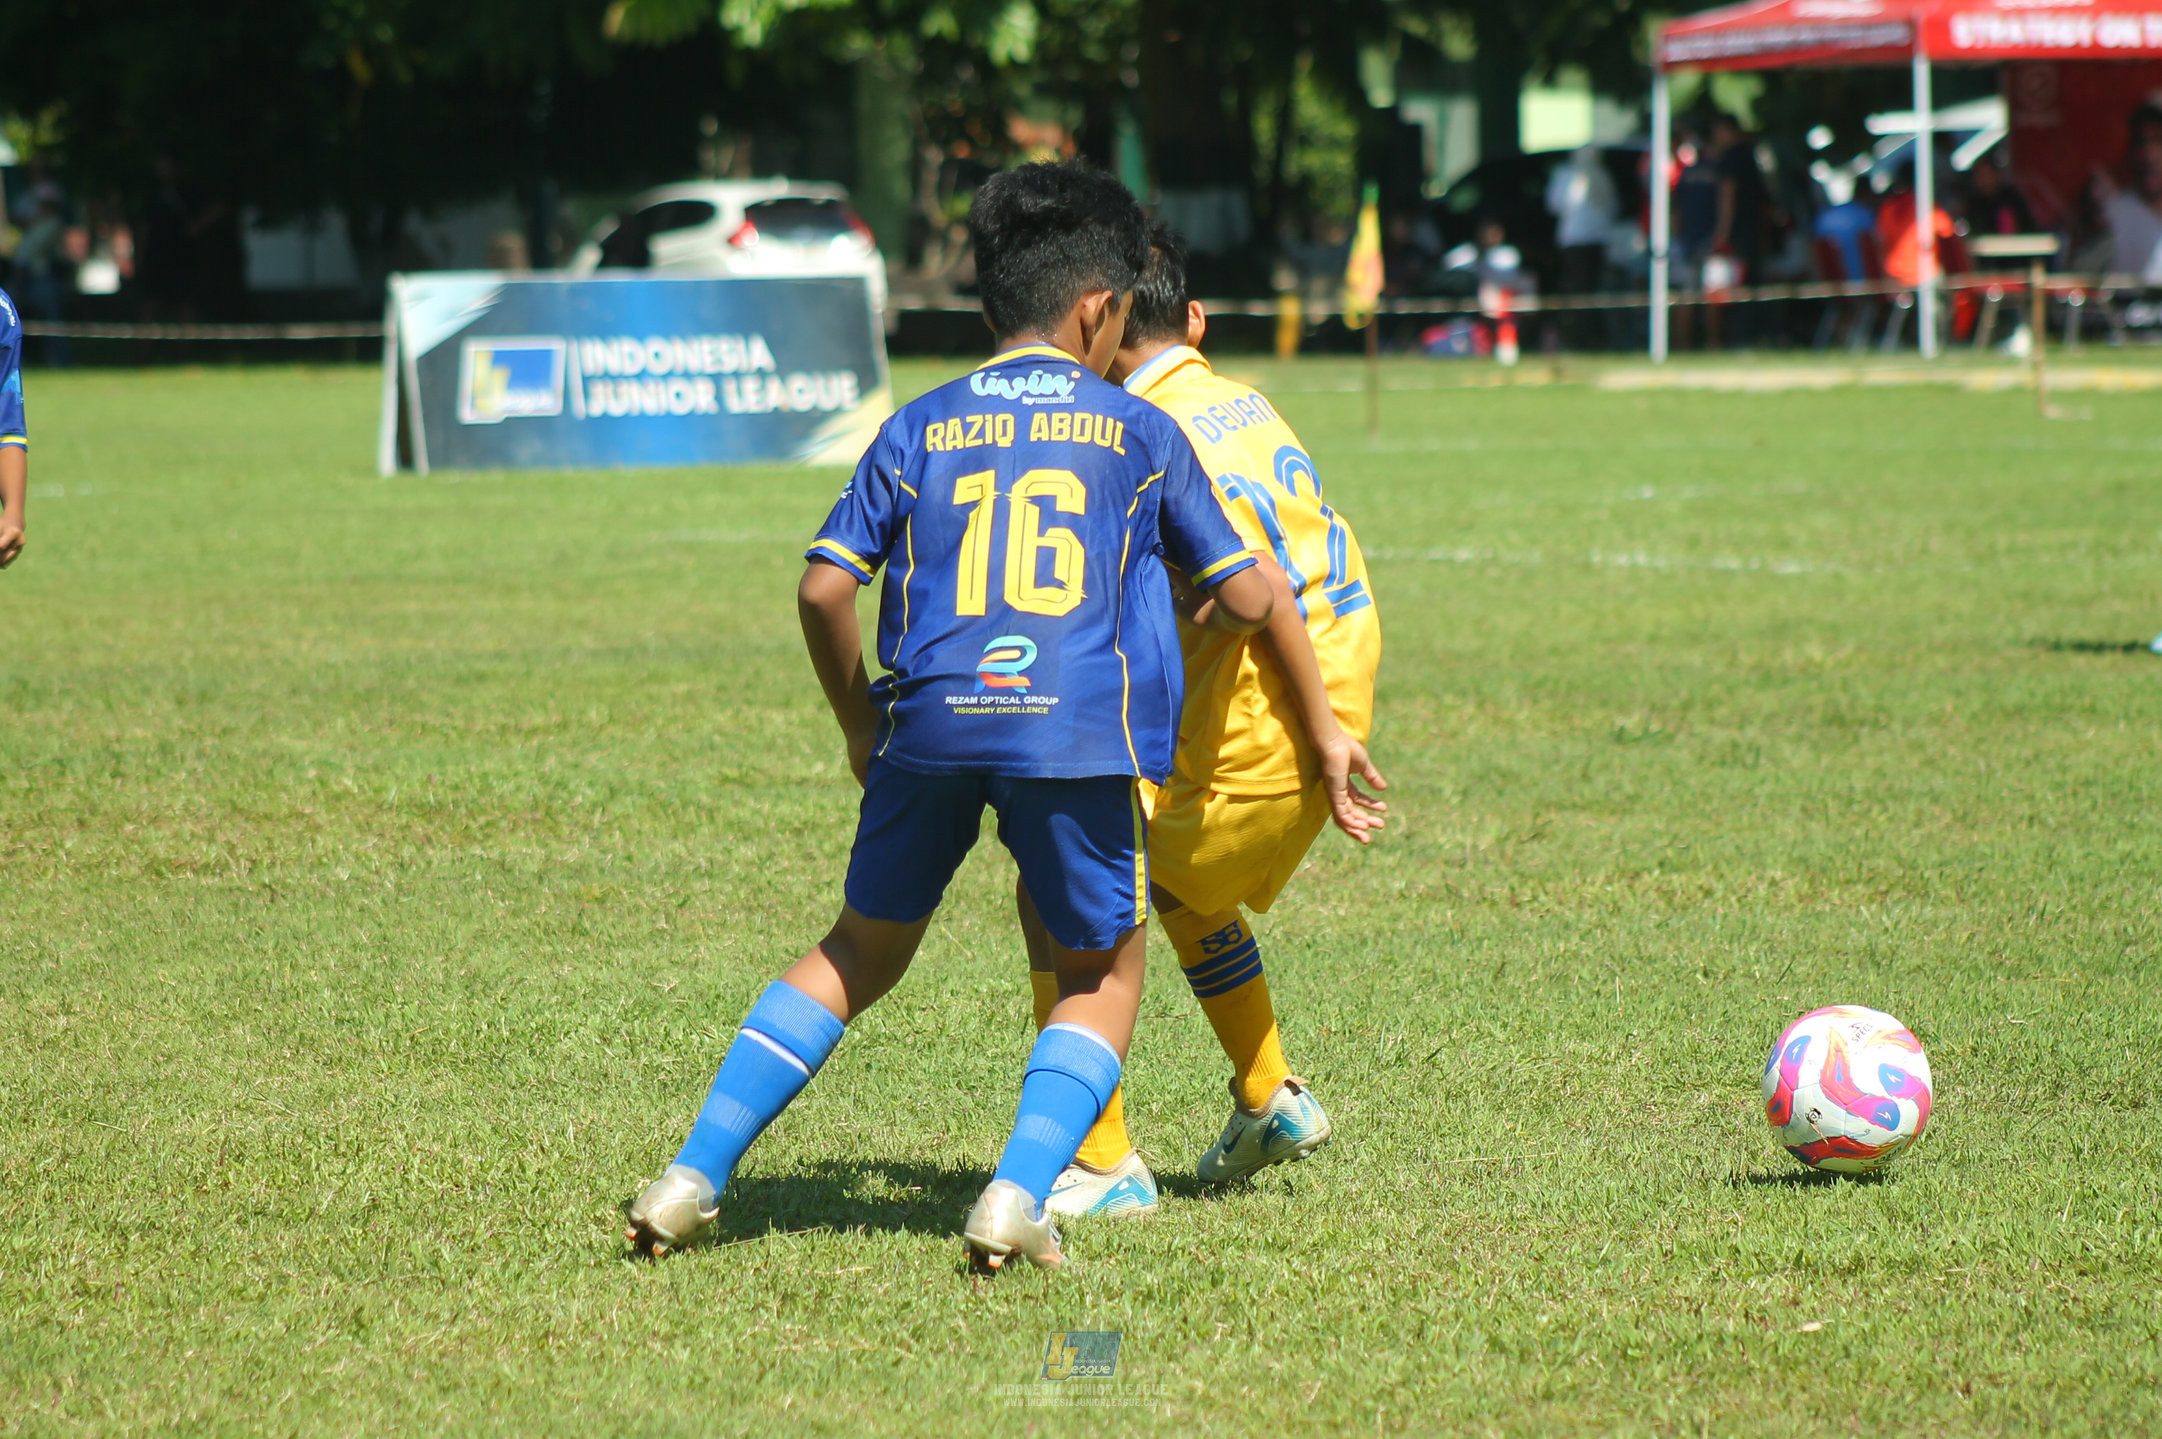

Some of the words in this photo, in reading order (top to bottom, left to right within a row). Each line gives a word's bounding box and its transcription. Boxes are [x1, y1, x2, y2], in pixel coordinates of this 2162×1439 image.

[581, 333, 777, 377] INDONESIA
[586, 376, 720, 418] JUNIOR
[721, 370, 861, 415] LEAGUE
[925, 412, 1016, 453] RAZIQ
[1029, 411, 1127, 457] ABDUL
[952, 468, 1089, 618] 16
[945, 695, 978, 706] REZAM
[979, 695, 1022, 706] OPTICAL
[1023, 695, 1060, 706] GROUP
[953, 705, 996, 715] VISIONARY
[996, 705, 1049, 715] EXCELLENCE
